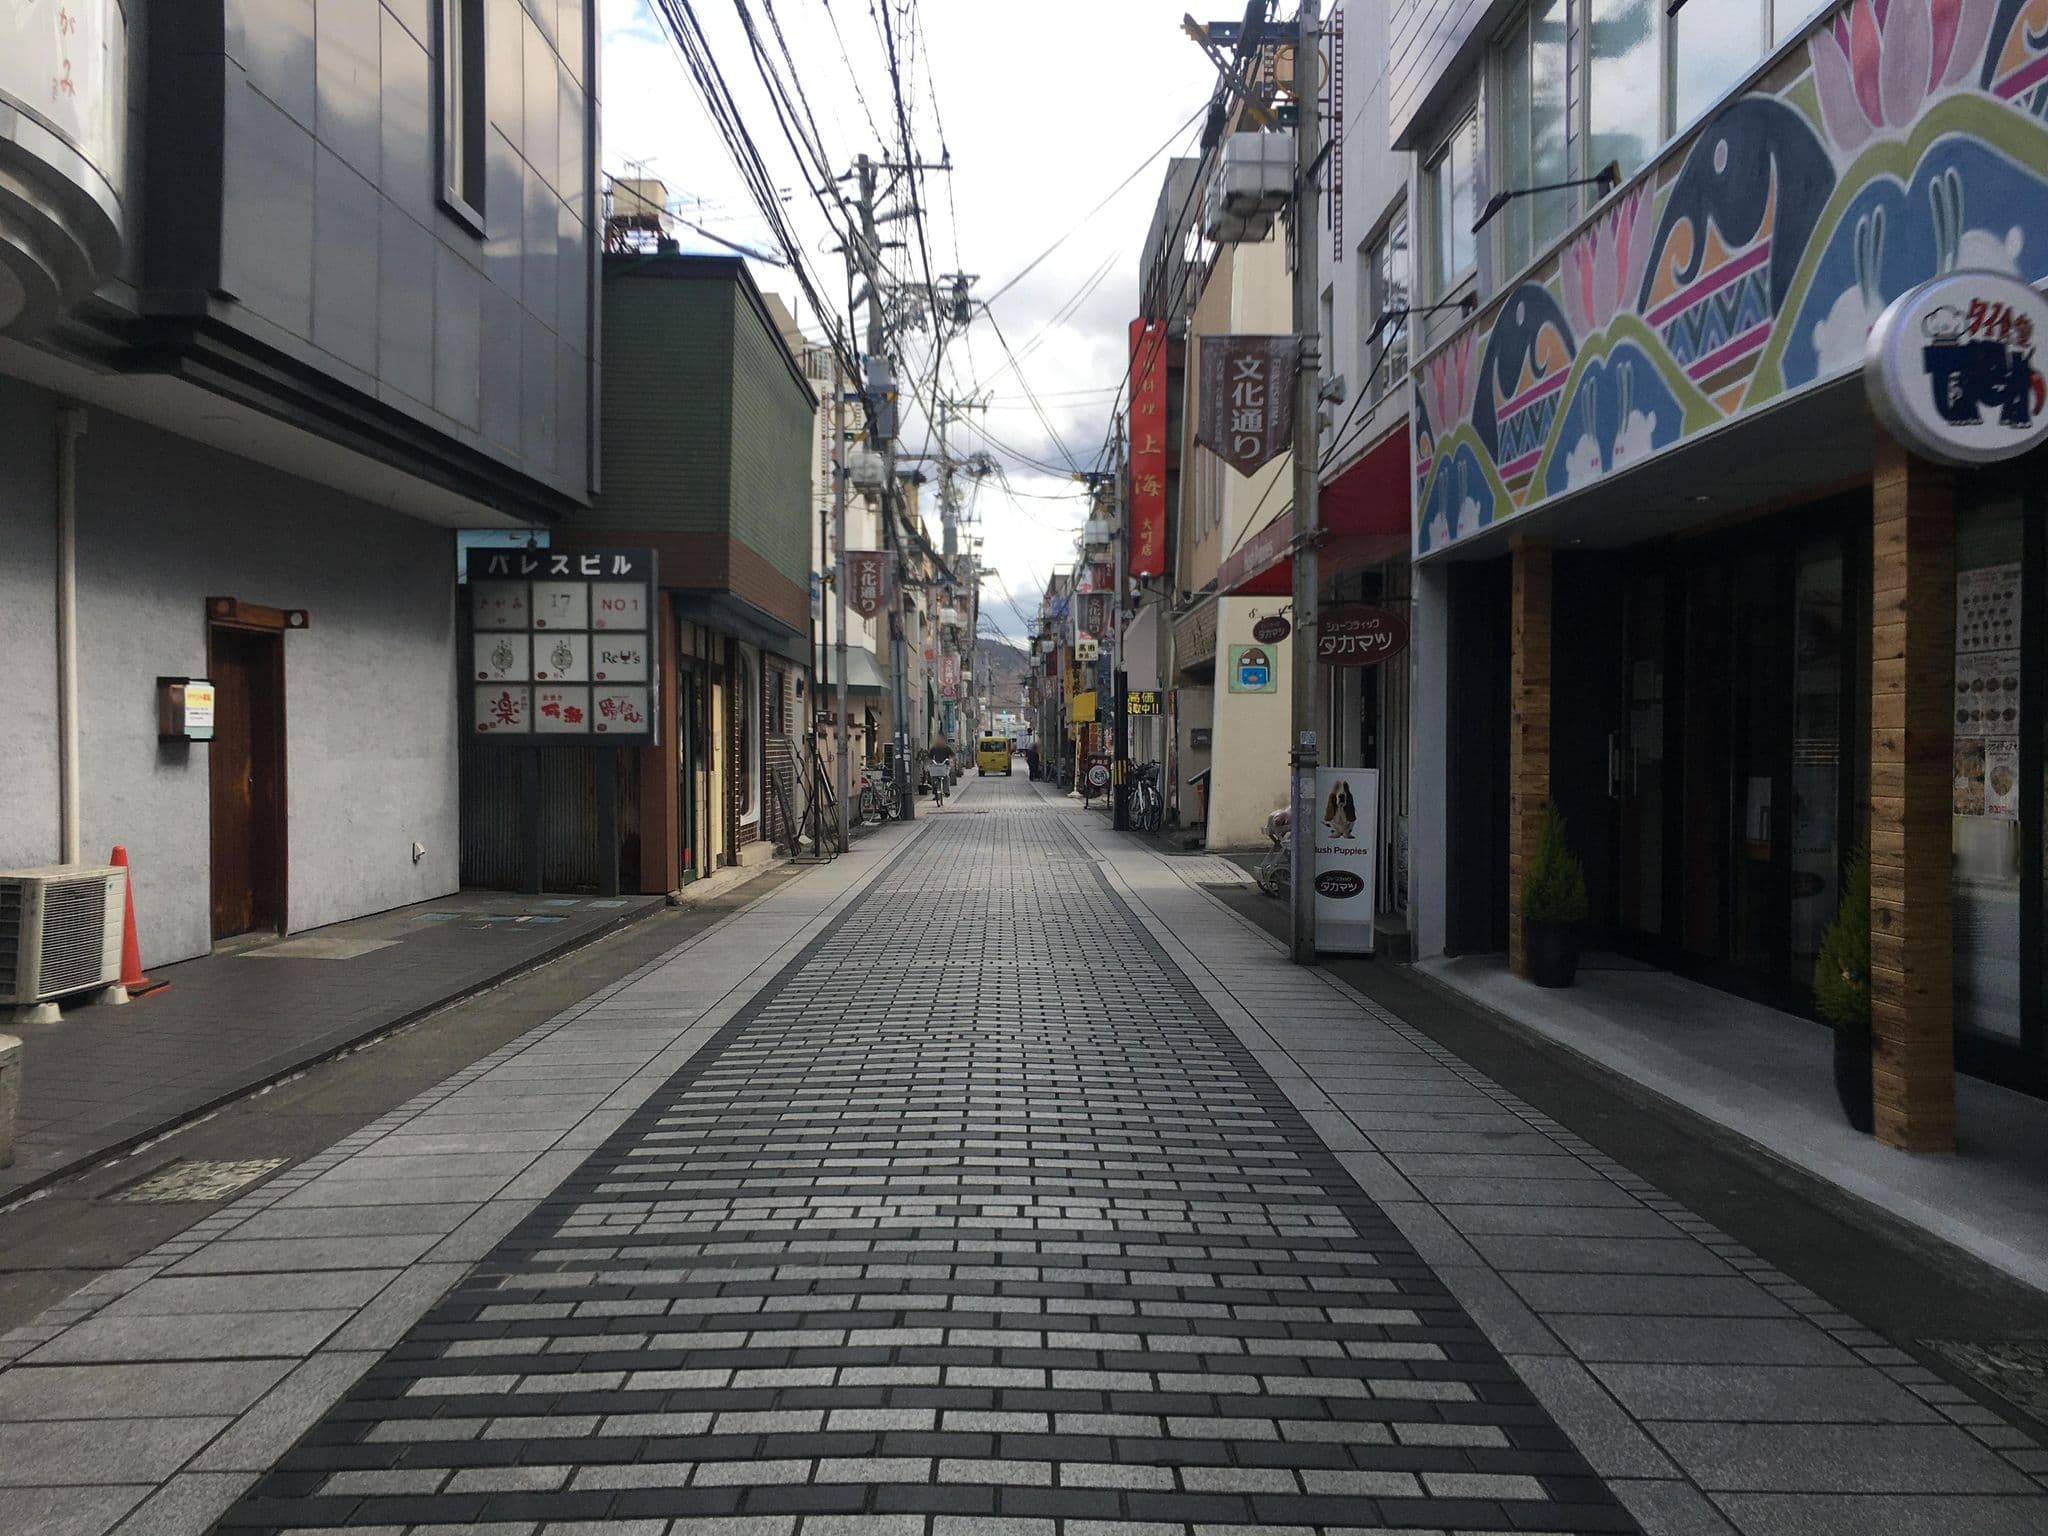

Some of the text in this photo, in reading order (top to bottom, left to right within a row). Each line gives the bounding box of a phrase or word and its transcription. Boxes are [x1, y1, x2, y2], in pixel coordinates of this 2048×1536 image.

[1230, 354, 1265, 460] 文化通り
[1134, 434, 1162, 497] 上海
[1139, 518, 1154, 558] 大町店
[488, 554, 632, 575] パレスビル
[861, 560, 878, 612] 文化通り
[602, 599, 639, 611] NO 1
[1318, 632, 1392, 655] タカマツ
[1334, 846, 1368, 856] Puppies
[1320, 881, 1358, 892] タカマツ
